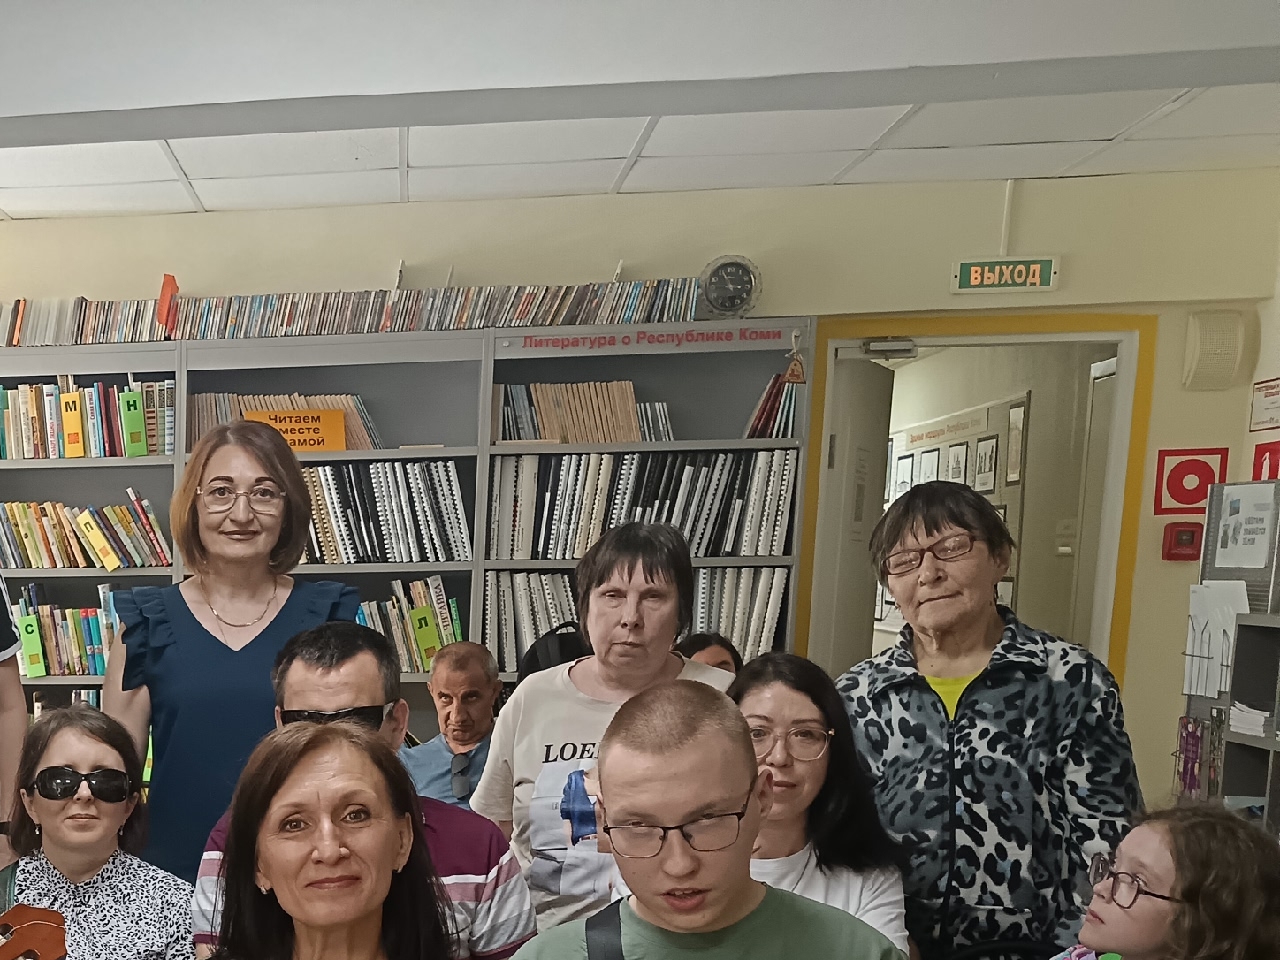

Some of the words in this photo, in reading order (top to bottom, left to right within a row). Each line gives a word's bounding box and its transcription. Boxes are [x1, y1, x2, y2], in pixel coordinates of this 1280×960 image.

[970, 264, 1041, 287] ВЫХОД
[521, 334, 617, 351] Литература
[621, 335, 631, 346] о
[635, 329, 734, 347] Республике
[738, 327, 783, 341] Коми
[64, 400, 78, 413] М
[126, 399, 138, 412] Н
[268, 414, 321, 424] Читаем
[277, 426, 321, 435] месте
[289, 436, 326, 447] амой
[24, 623, 35, 635] С
[417, 616, 429, 630] Л
[542, 742, 600, 764] LOE
